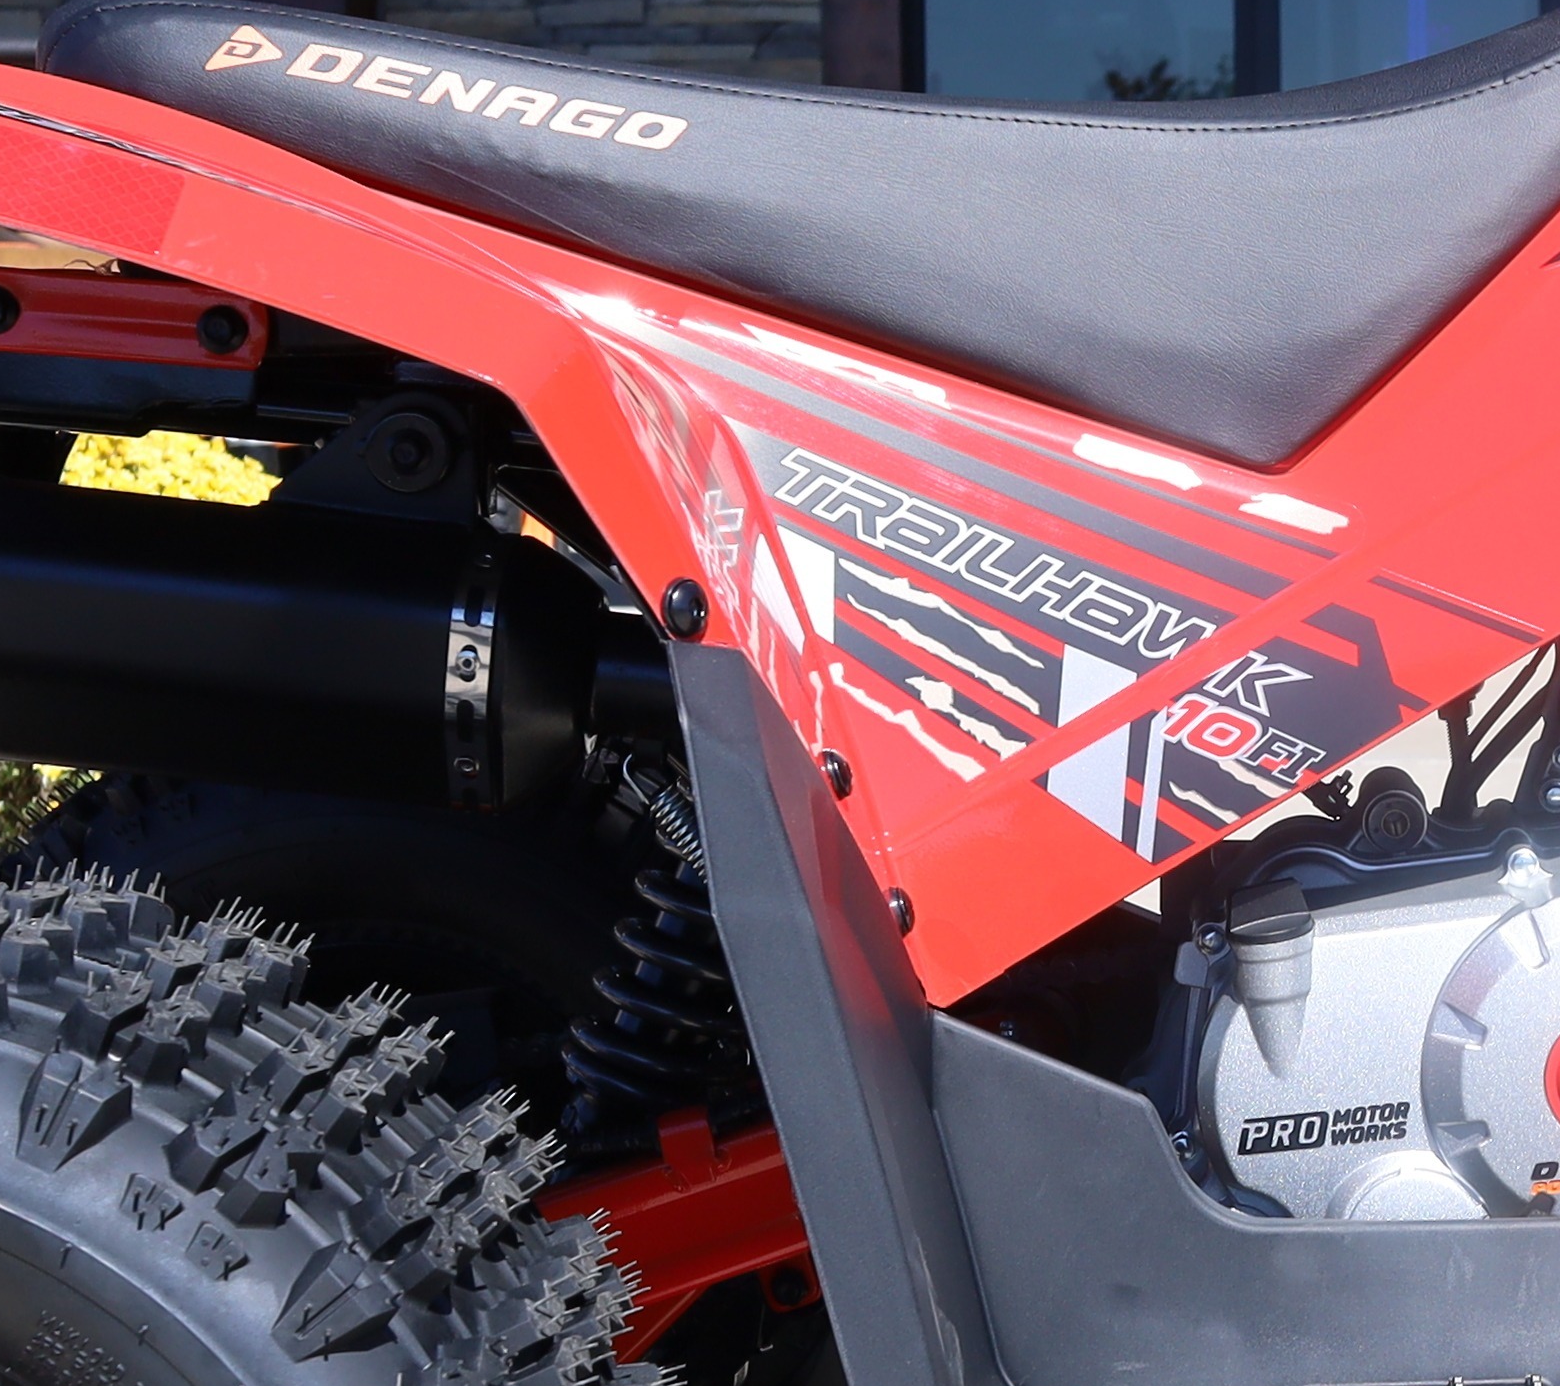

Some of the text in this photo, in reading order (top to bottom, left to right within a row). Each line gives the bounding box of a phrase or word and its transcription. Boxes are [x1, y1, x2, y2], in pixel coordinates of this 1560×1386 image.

[286, 43, 688, 150] DENAGO
[1332, 1102, 1410, 1127] MOTOR
[1243, 1114, 1324, 1152] PRO
[1331, 1121, 1408, 1146] WORKS
